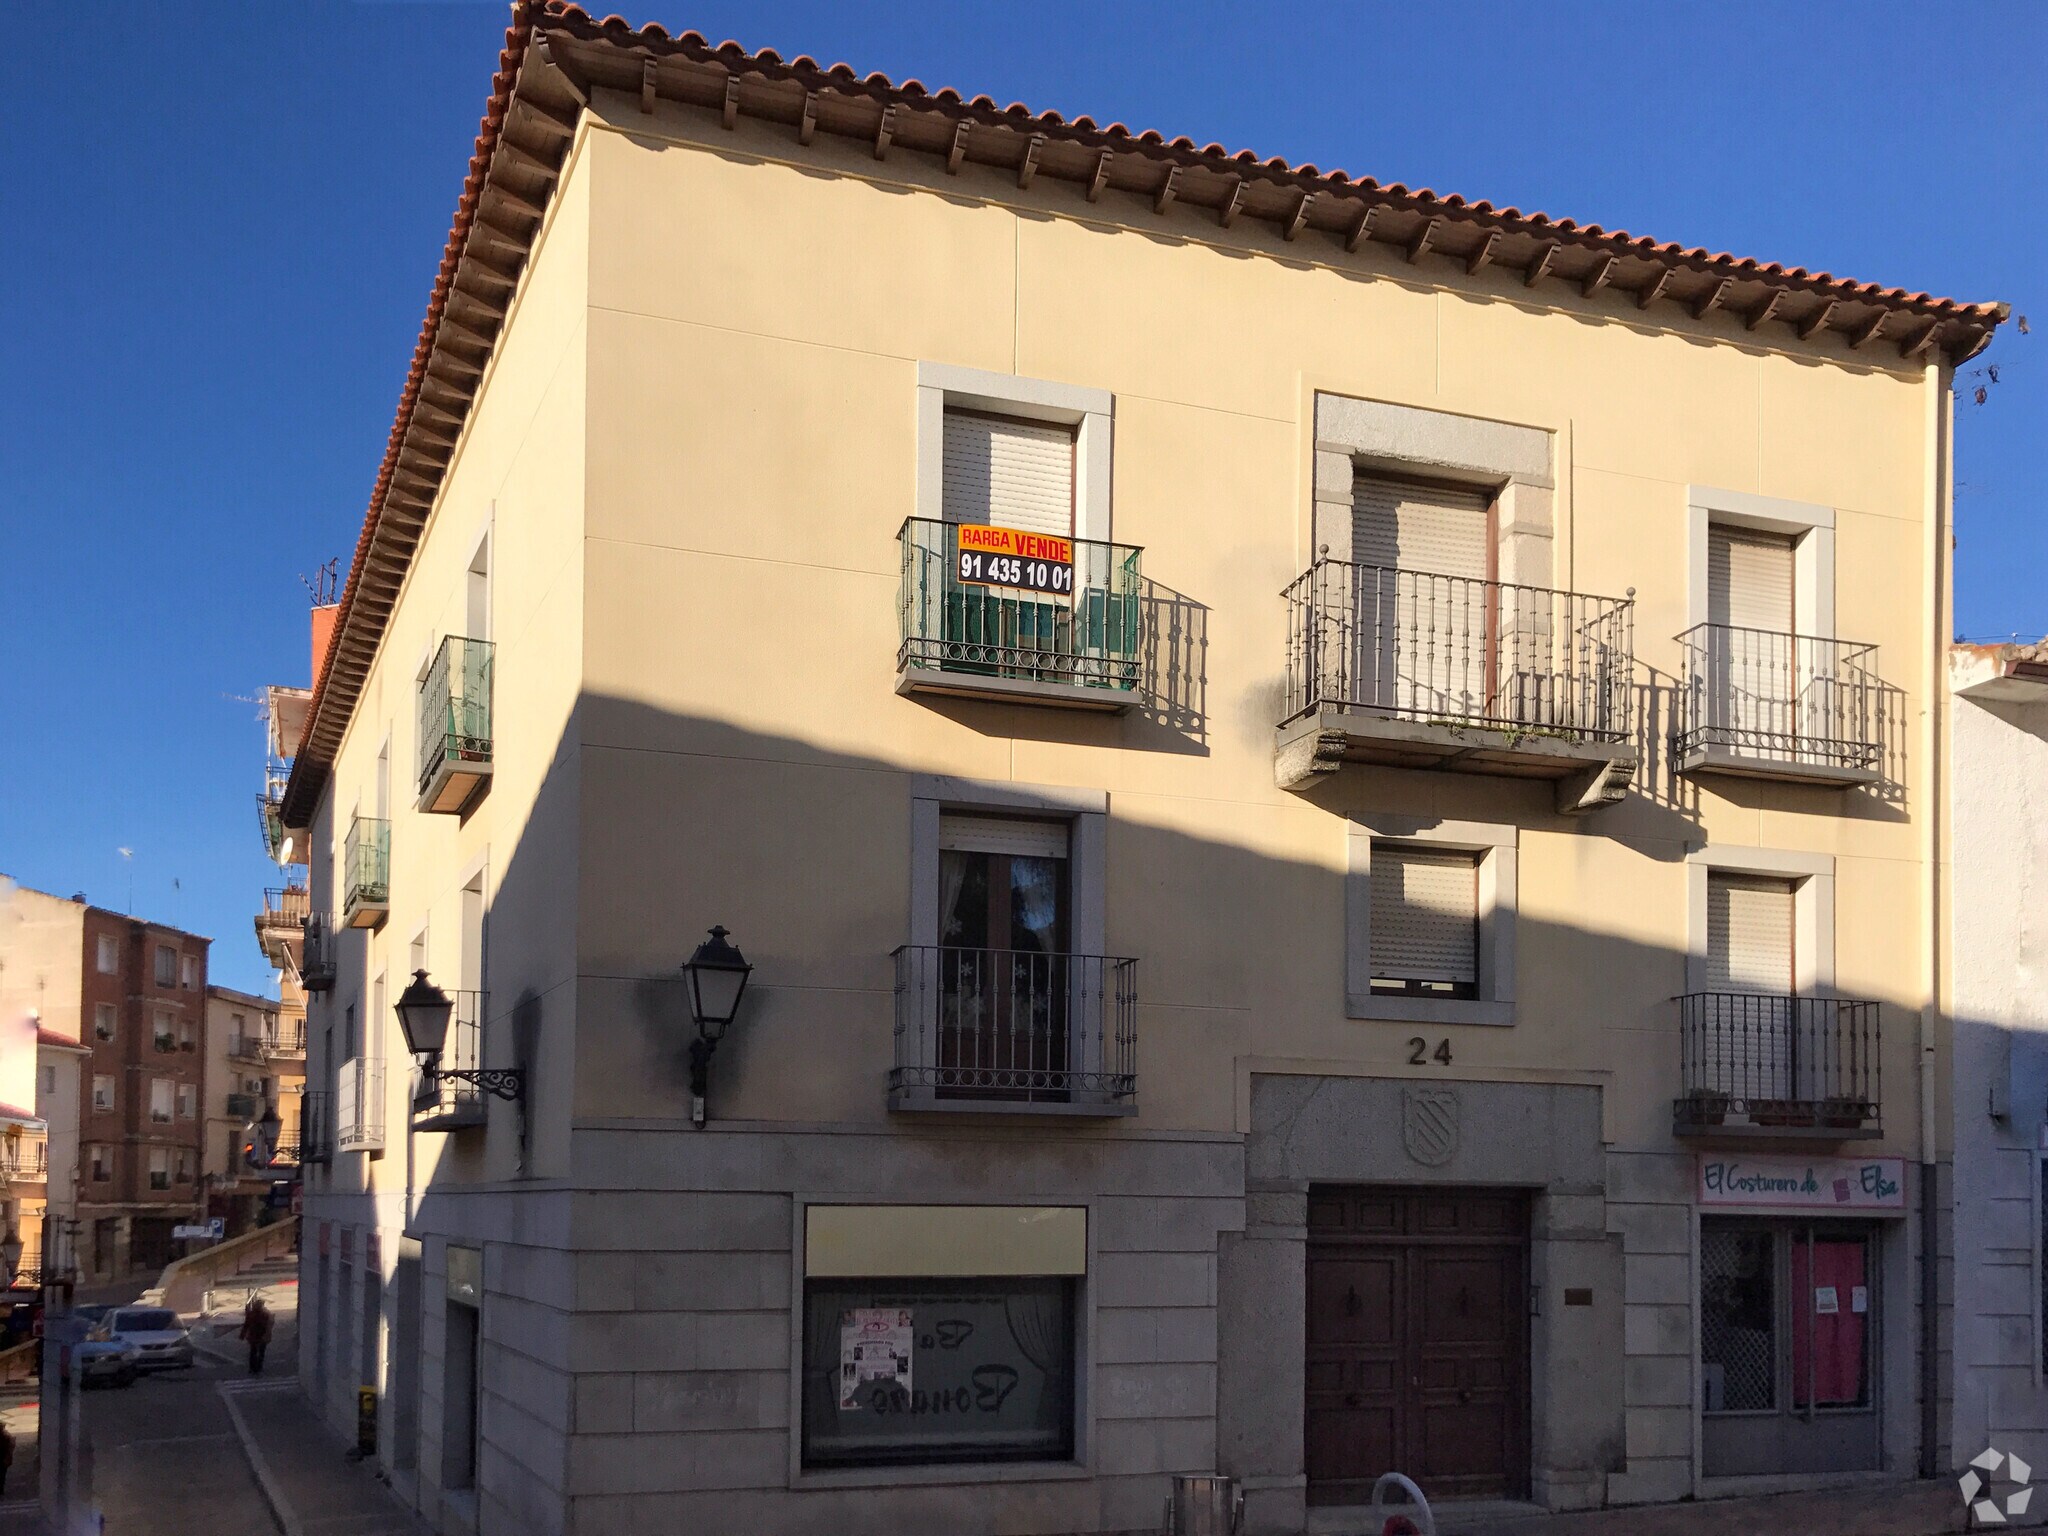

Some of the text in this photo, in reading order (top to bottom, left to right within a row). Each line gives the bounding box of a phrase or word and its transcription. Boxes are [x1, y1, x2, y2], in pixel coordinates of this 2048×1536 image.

[963, 528, 1068, 562] RARGA VENDE
[961, 553, 1072, 591] 91 435 10 01
[1409, 1036, 1453, 1066] 24
[1704, 1162, 1899, 1199] El Costurero de Elsa
